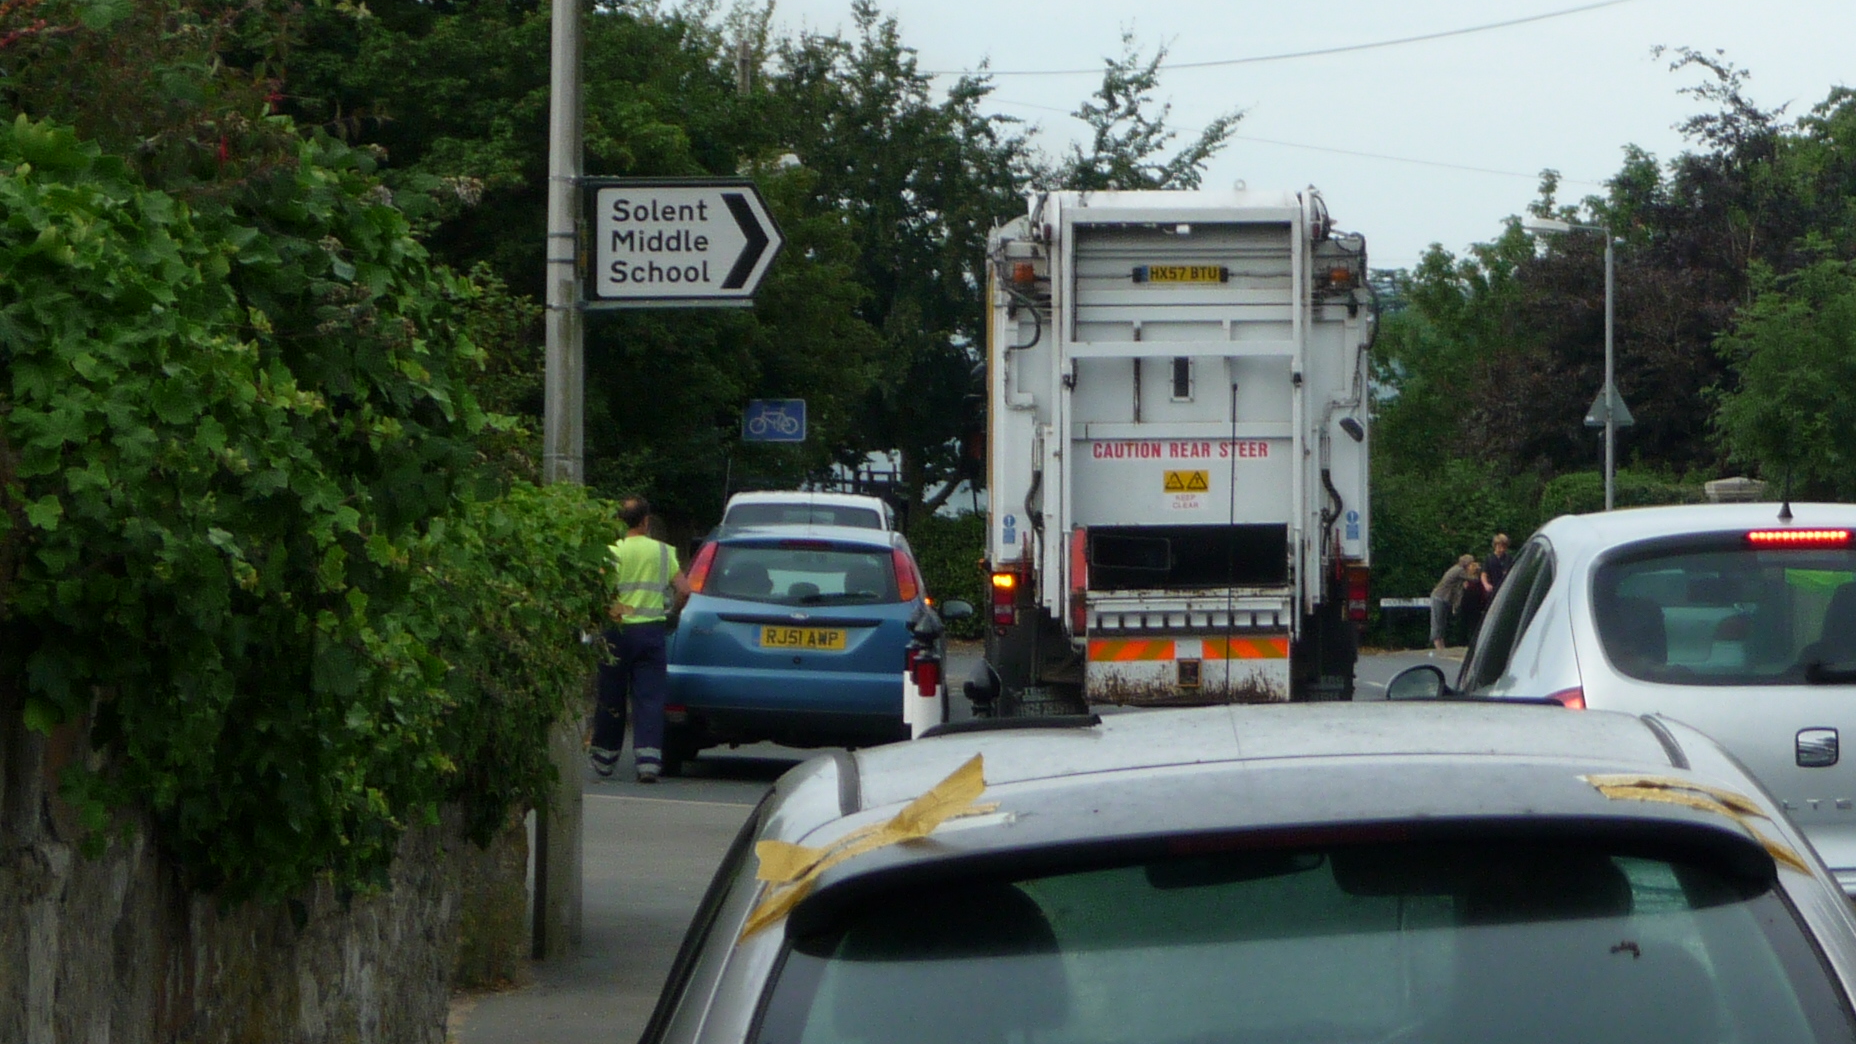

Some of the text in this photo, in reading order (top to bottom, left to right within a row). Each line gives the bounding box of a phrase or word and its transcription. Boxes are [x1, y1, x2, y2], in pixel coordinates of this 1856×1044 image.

[611, 199, 708, 222] Solent
[611, 229, 709, 252] Middle
[610, 260, 710, 283] School
[1150, 267, 1217, 280] HX57 BTU
[1093, 441, 1268, 459] CAUTION REAR STEER
[765, 629, 839, 646] RJ51 AWP
